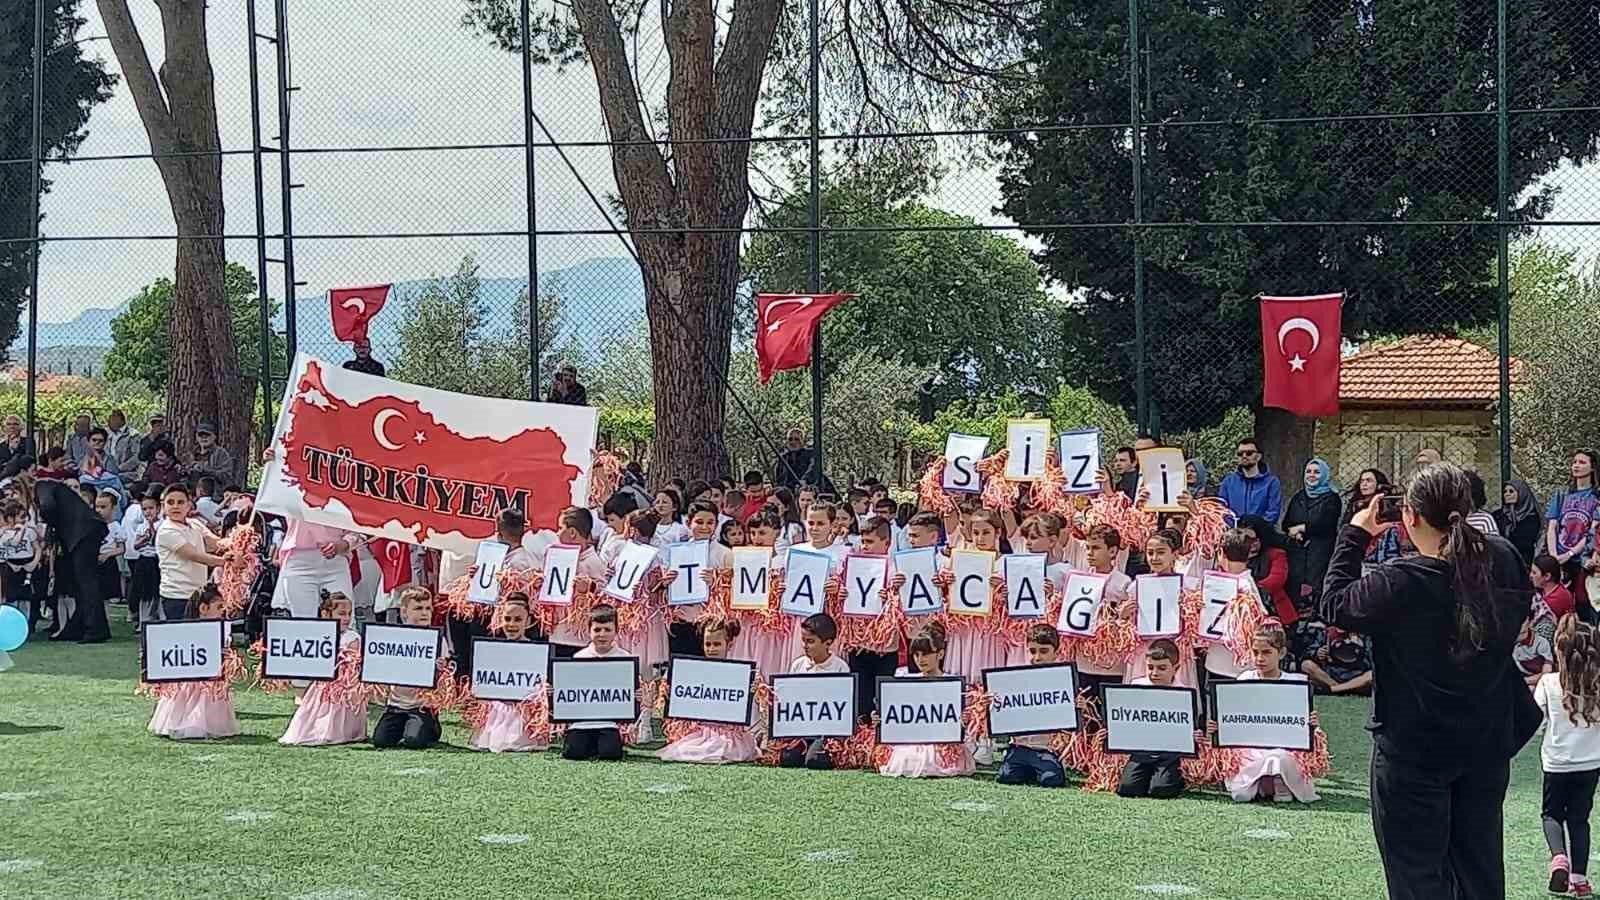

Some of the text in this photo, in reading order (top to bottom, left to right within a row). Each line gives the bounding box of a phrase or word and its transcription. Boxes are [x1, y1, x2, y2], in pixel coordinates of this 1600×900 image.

[953, 456, 971, 486] S
[1071, 455, 1092, 488] Z
[303, 446, 531, 525] TÜRKİYEM
[479, 563, 496, 589] U
[547, 566, 570, 595] N
[616, 560, 639, 590] U
[679, 563, 700, 593] T
[740, 567, 766, 594] M
[790, 574, 815, 606] A
[856, 577, 876, 608] Y
[908, 573, 934, 608] A
[959, 574, 983, 608] C
[1015, 577, 1040, 610] A
[1066, 587, 1093, 631] Ğ
[1206, 599, 1229, 635] Z
[161, 644, 207, 667] KİLİS
[270, 636, 332, 658] ELAZIĞ
[368, 641, 434, 659] OSMANİYE
[476, 670, 542, 687] MALATYA
[557, 689, 631, 703] ADIYAMAN
[675, 684, 744, 702] GAZİANTEP
[993, 690, 1071, 712] ŞANLIURFA
[777, 701, 846, 721] HATAY
[885, 703, 958, 724] ADANA
[1111, 707, 1189, 724] DİYARBAKIR
[1222, 714, 1306, 726] KAHRAMANMARAŞ
